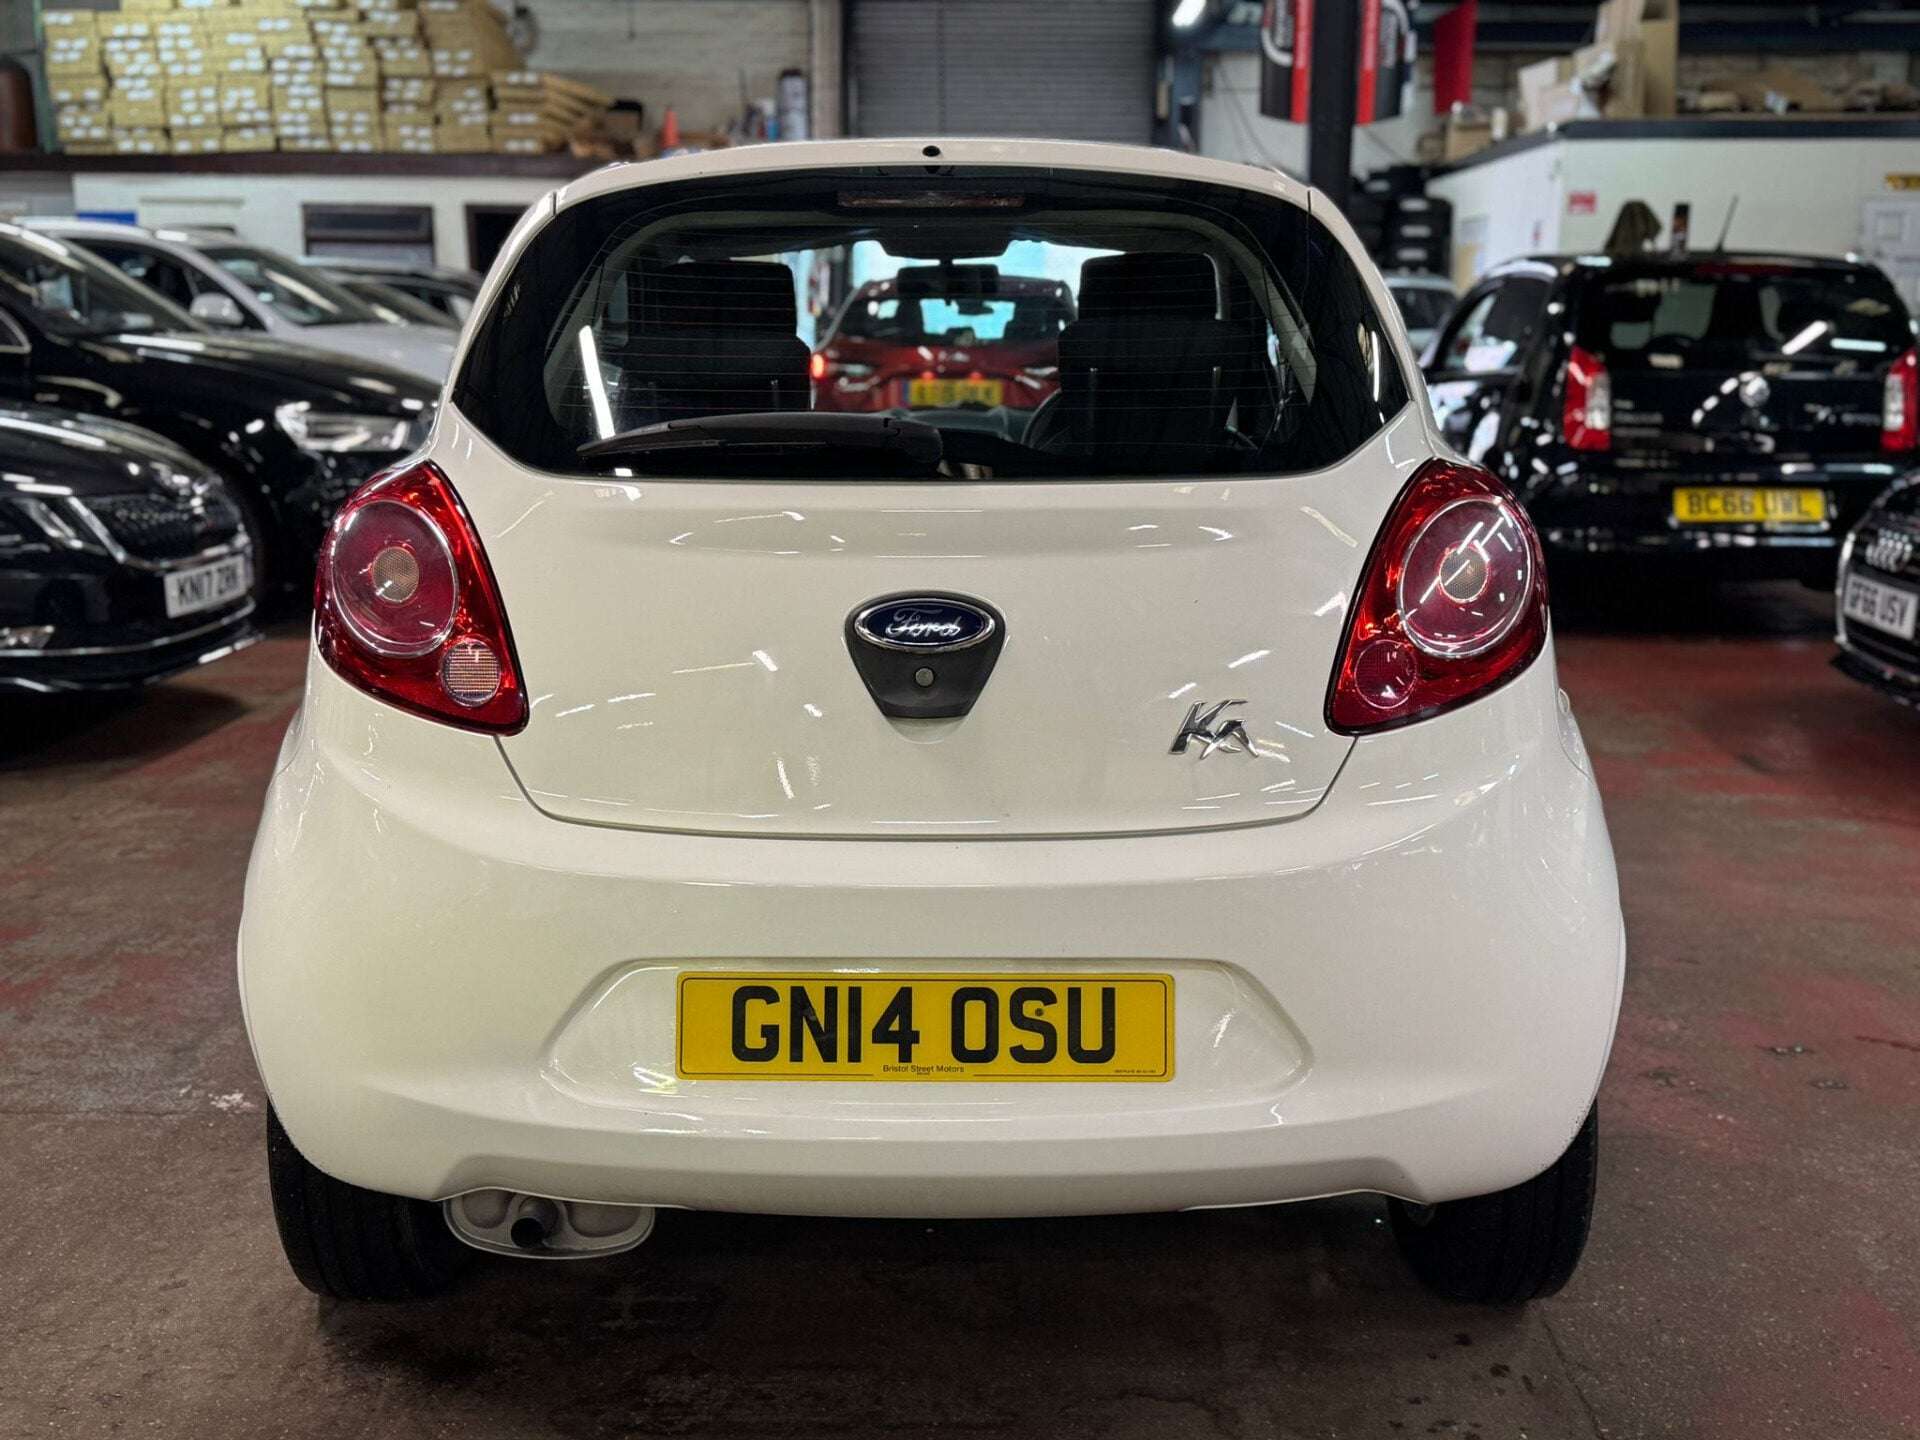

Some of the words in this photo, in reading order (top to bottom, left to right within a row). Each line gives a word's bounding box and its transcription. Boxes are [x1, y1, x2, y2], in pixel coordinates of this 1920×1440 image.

[885, 607, 963, 637] Ford
[731, 985, 920, 1063] GN14
[950, 986, 1116, 1064] OSU
[882, 1064, 909, 1073] Bristol
[910, 1064, 934, 1074] Street
[936, 1064, 965, 1073] Motors
